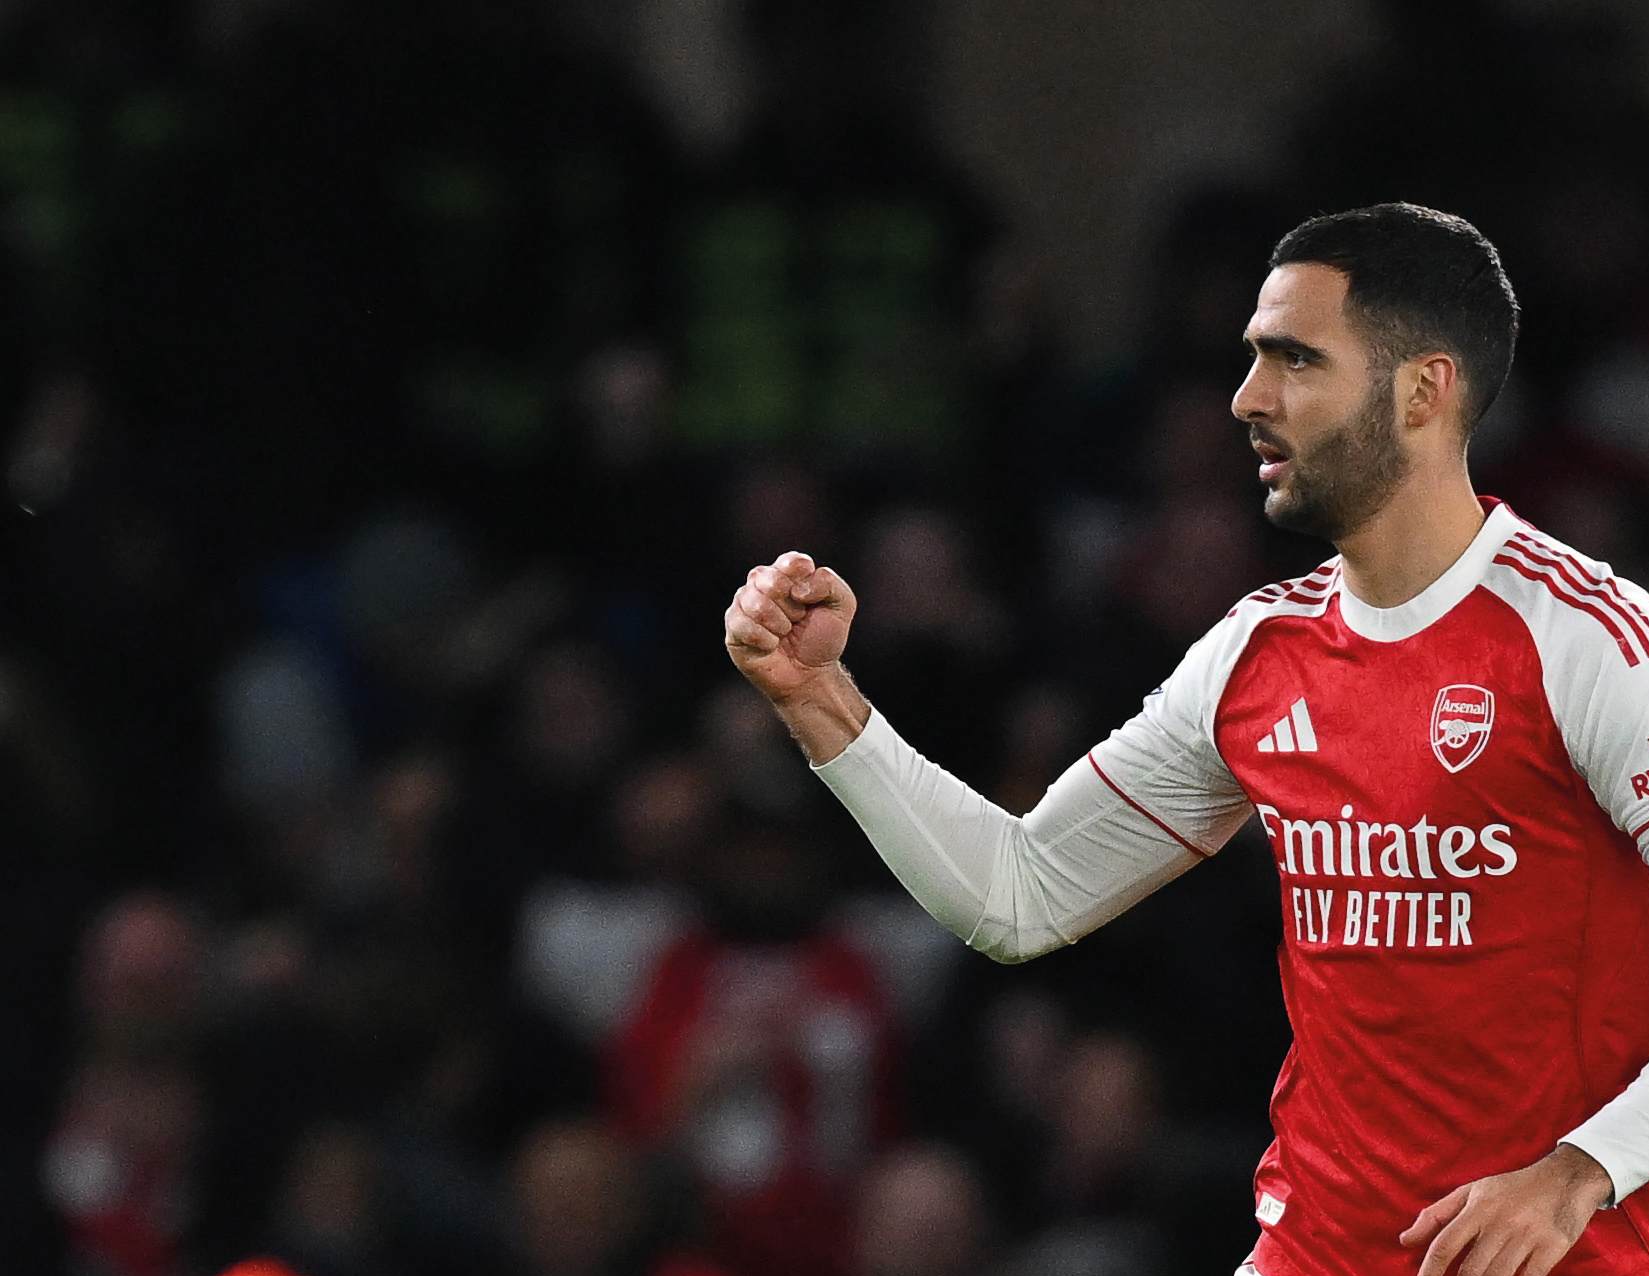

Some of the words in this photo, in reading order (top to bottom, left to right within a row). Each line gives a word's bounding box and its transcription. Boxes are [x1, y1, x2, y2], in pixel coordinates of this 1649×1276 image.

[1441, 699, 1485, 715] Arsenal
[1292, 887, 1333, 943] FLY
[1343, 890, 1473, 947] BETTER
